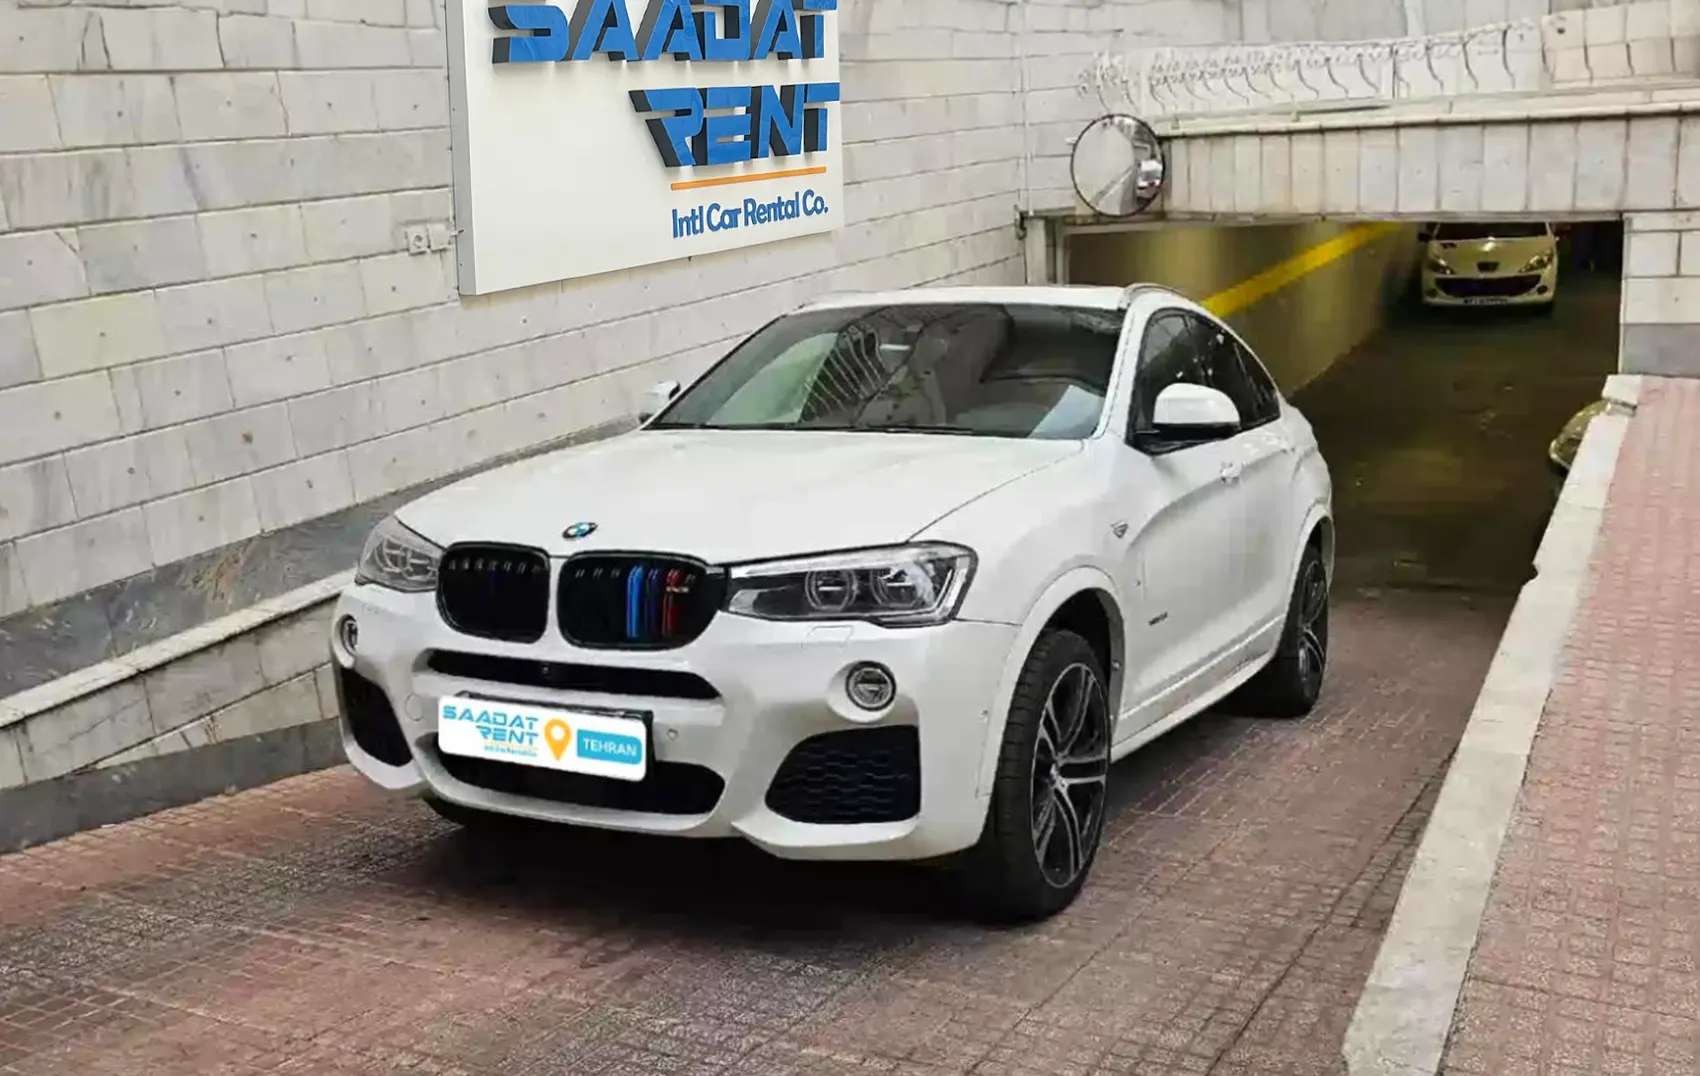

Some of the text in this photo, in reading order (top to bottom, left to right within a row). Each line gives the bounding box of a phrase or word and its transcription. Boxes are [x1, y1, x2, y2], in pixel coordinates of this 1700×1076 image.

[488, 0, 837, 63] SAADAT
[629, 82, 840, 167] RENT
[672, 189, 829, 238] Intl Car Rental Co.
[443, 705, 539, 730] SAADAT
[476, 725, 539, 746] RENT
[583, 738, 638, 757] TEHRAN
